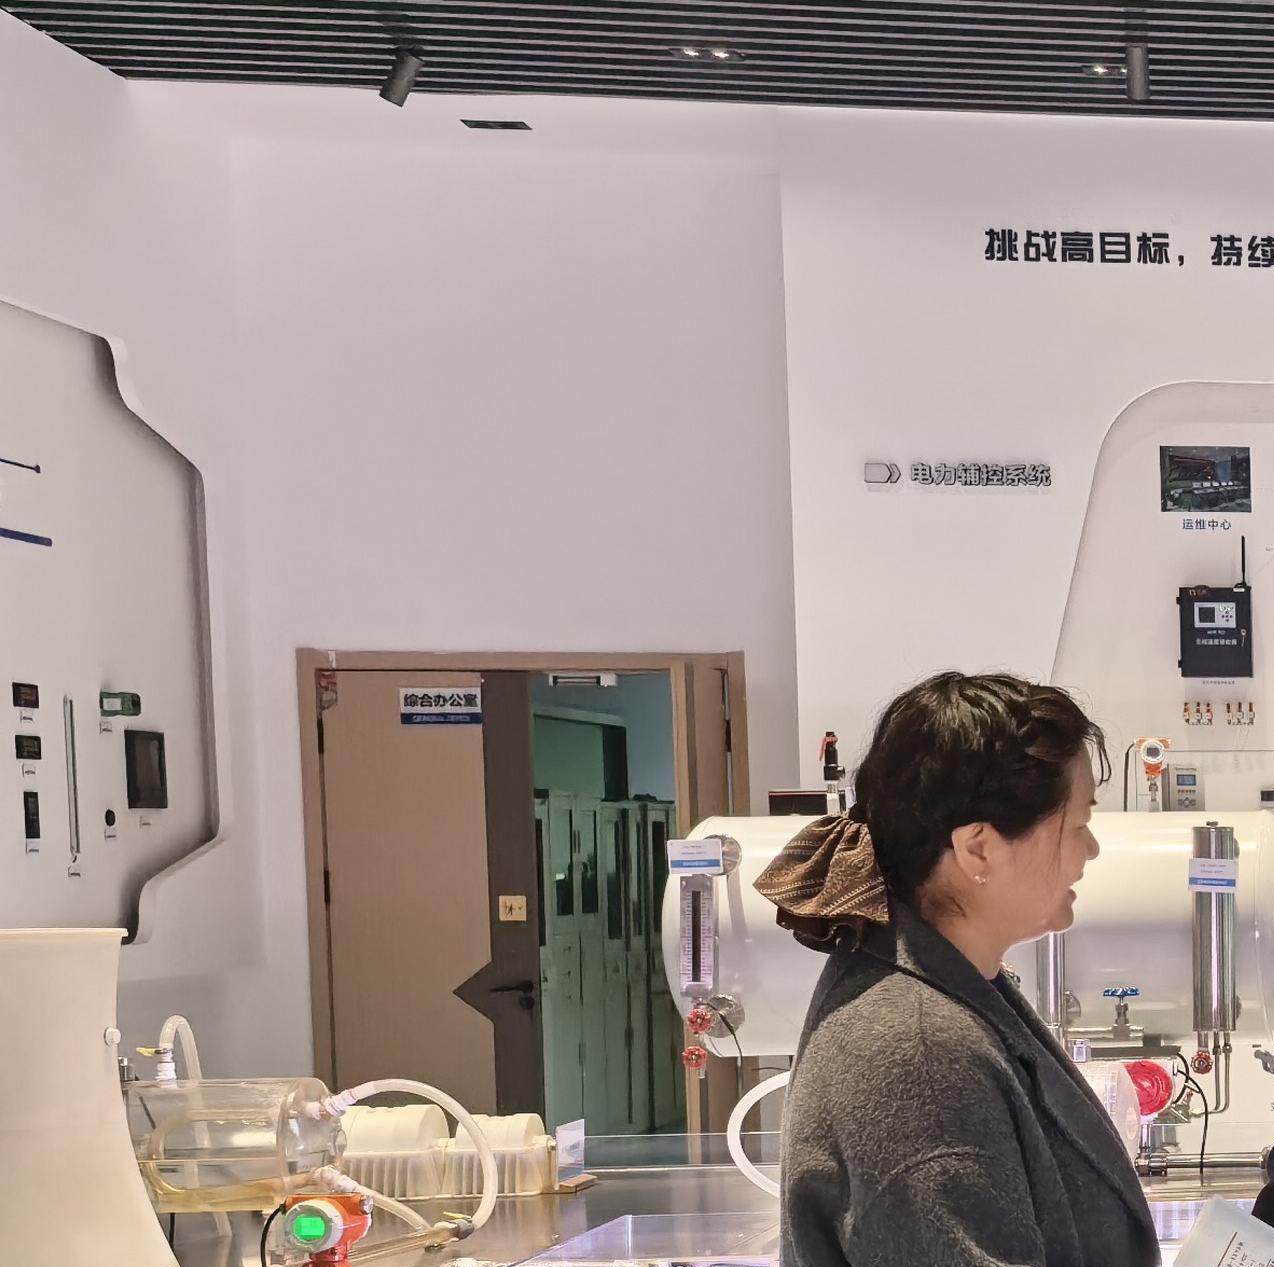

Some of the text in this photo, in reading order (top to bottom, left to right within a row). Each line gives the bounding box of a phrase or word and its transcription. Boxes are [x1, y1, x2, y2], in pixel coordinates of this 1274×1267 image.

[911, 462, 1052, 487] 电力辅控系统
[1182, 518, 1232, 531] 运维中心
[404, 693, 478, 708] 综合办公室
